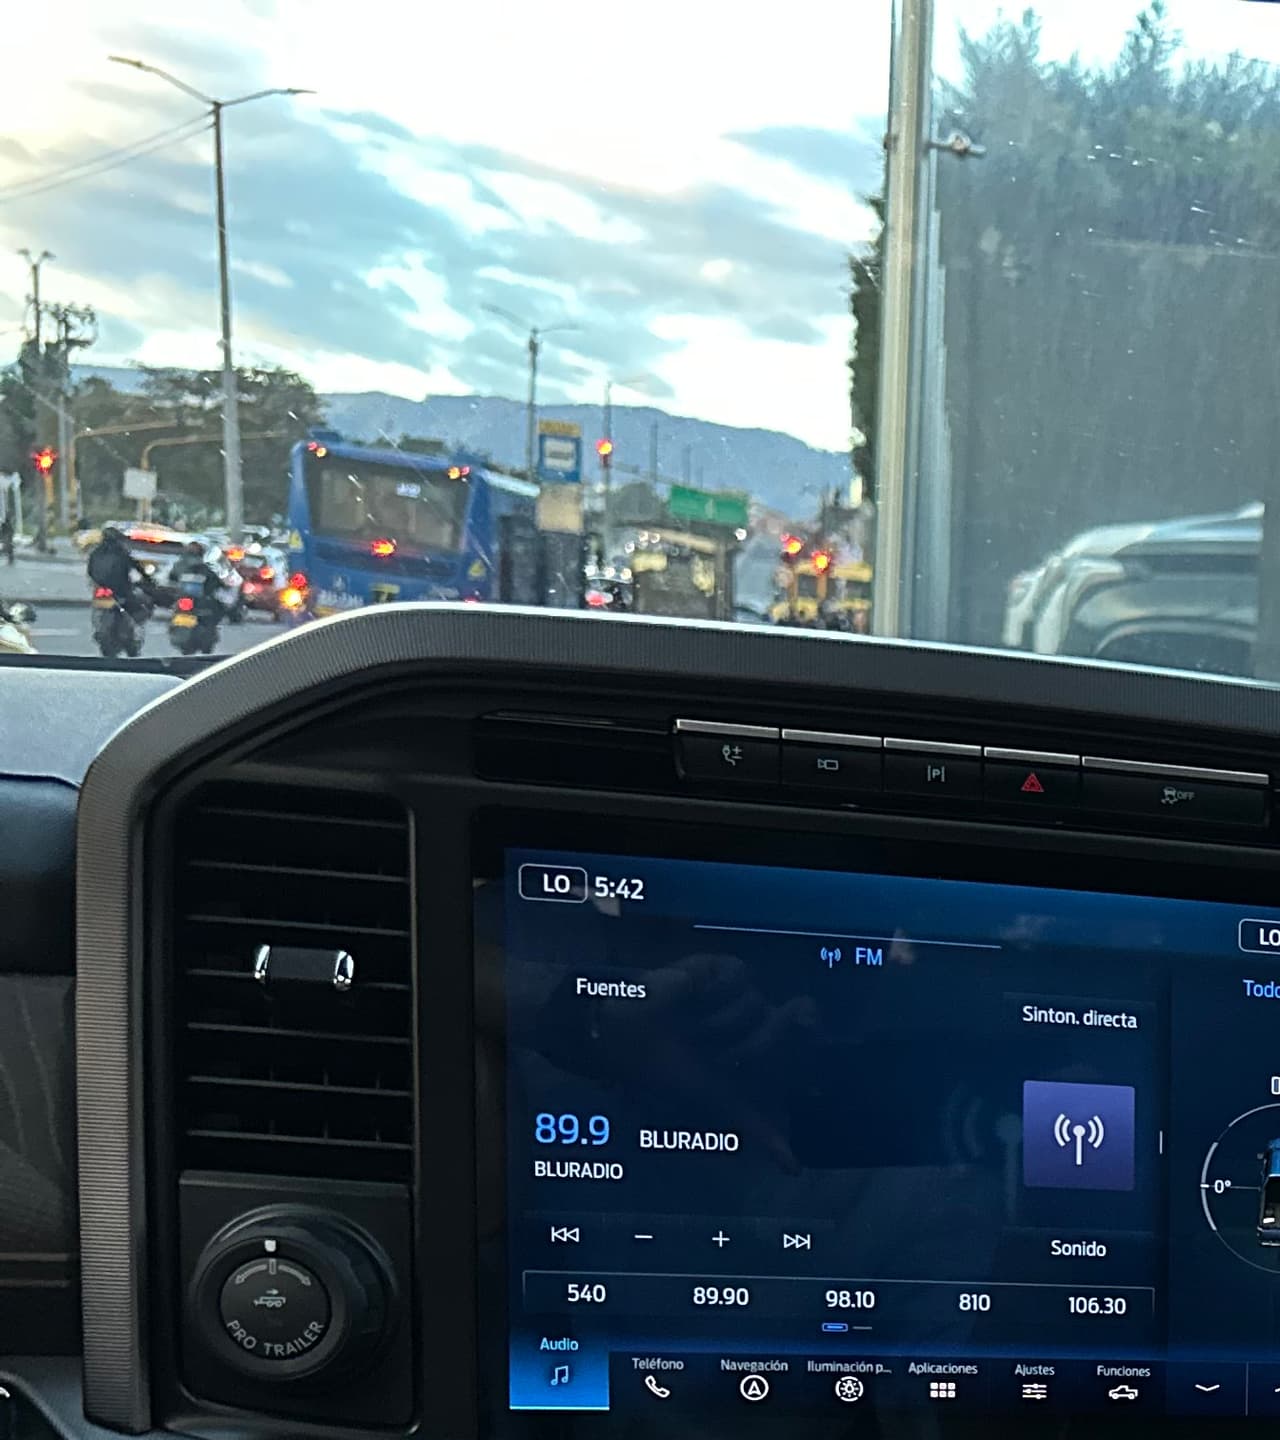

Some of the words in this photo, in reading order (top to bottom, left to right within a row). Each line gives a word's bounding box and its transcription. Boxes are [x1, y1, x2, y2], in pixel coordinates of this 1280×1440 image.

[1176, 791, 1196, 801] OFF
[543, 873, 571, 894] LO
[594, 876, 645, 900] 5:42
[855, 946, 883, 967] FM
[576, 977, 647, 998] Fuentes
[1022, 1005, 1080, 1026] Sinton.
[1083, 1009, 1138, 1029] directa
[535, 1112, 611, 1146] 89.9
[639, 1129, 740, 1153] BLURADIO
[534, 1160, 624, 1180] BLURADIO
[1050, 1238, 1108, 1258] Sonido
[567, 1283, 606, 1303] 540
[693, 1286, 749, 1306] 89.90
[825, 1289, 875, 1309] 98.10
[958, 1293, 991, 1312] 810
[1068, 1296, 1127, 1316] 106.30
[226, 1319, 257, 1350] PRO
[263, 1320, 325, 1357] TRAILER
[540, 1336, 579, 1352] Audio
[631, 1356, 685, 1371] Teléfono
[720, 1358, 789, 1374] Navegación
[807, 1359, 874, 1373] Iluminación
[908, 1361, 979, 1377] Aplicaciones
[1014, 1363, 1056, 1378] Ajustes
[1096, 1364, 1152, 1378] Funciones
